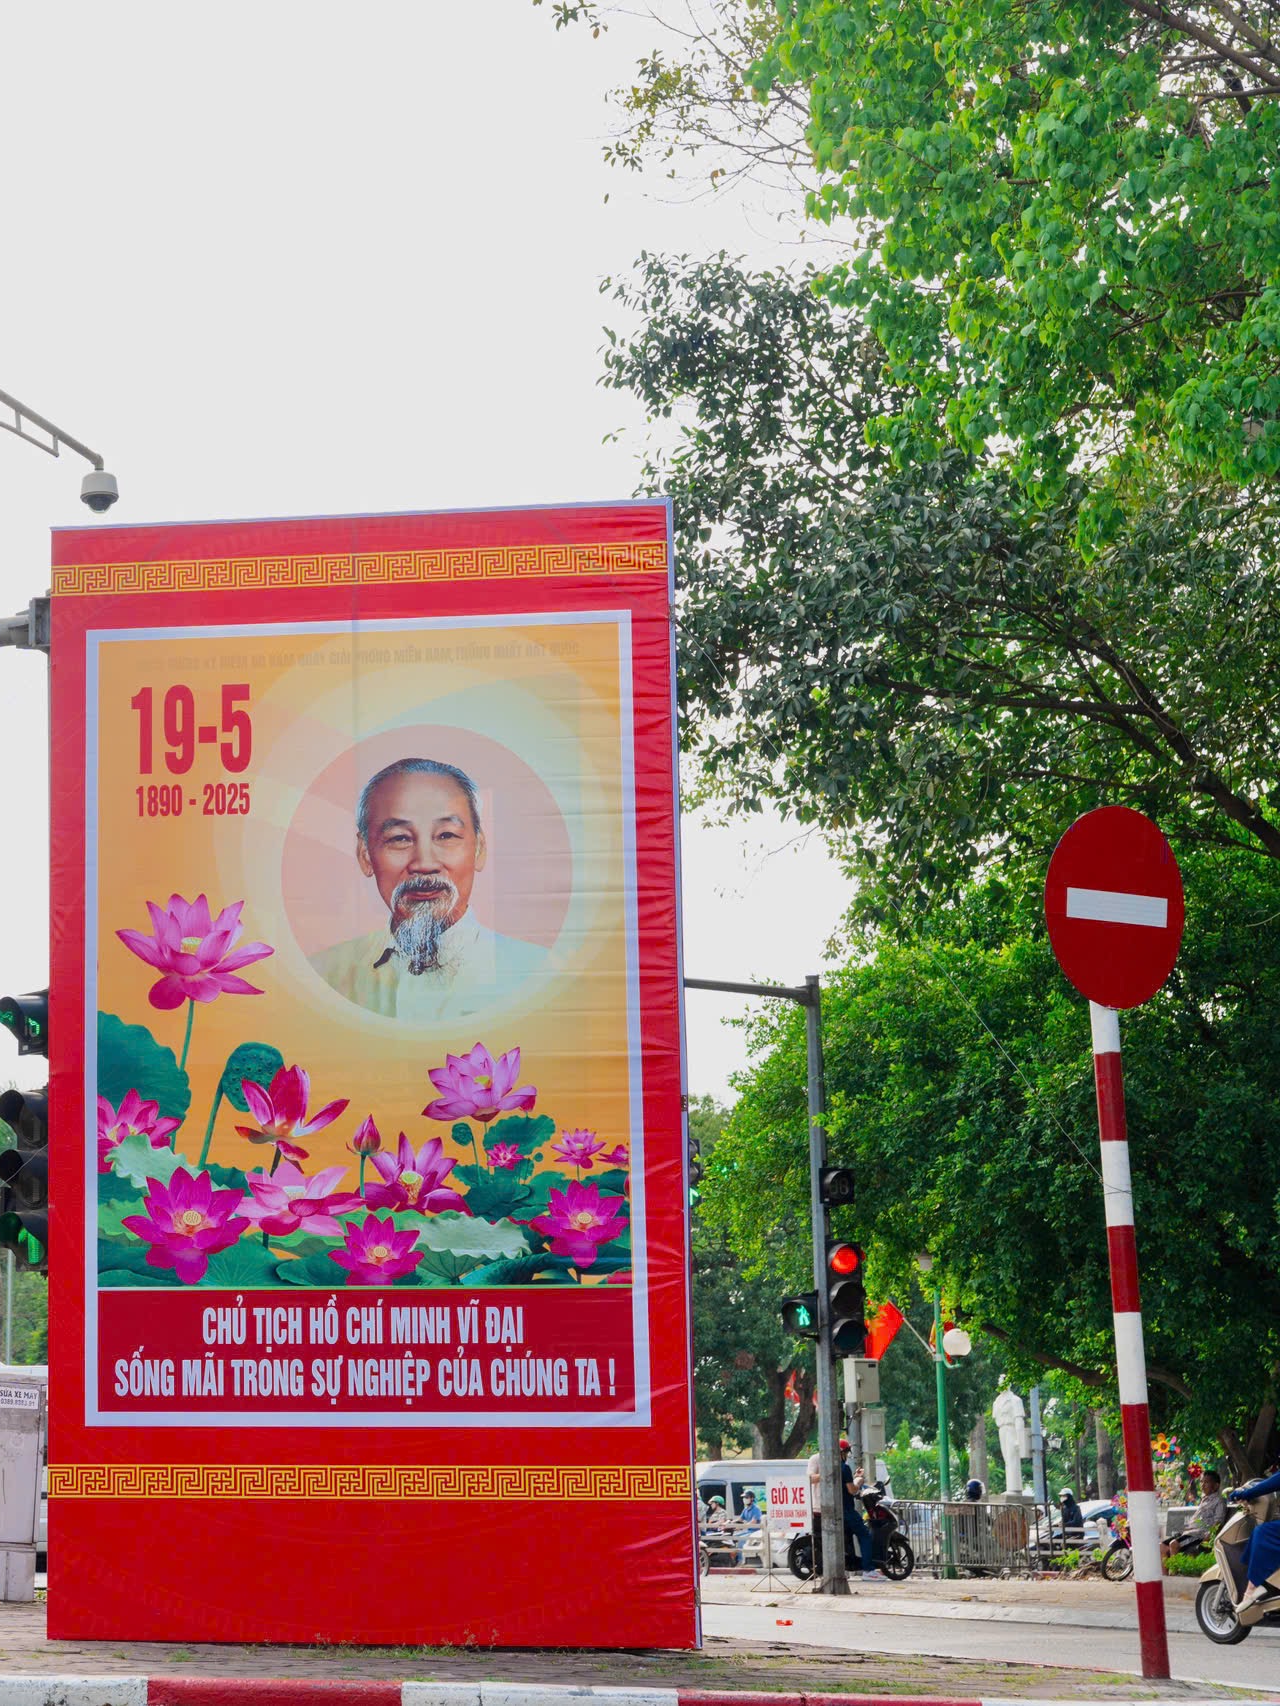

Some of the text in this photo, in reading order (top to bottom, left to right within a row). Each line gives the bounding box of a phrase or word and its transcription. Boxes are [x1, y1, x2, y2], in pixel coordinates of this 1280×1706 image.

[132, 684, 251, 774] 19-5
[136, 784, 182, 817] 1890
[203, 783, 250, 816] 2025
[202, 1294, 524, 1352] CHỦ TỊCH HỒ CHÍ MINH VĨ ĐẠI
[115, 1345, 616, 1405] SỐNG MÃI TRONG SỰ NGHIỆP CỦA CHÚNG TA !
[791, 1487, 805, 1505] XE
